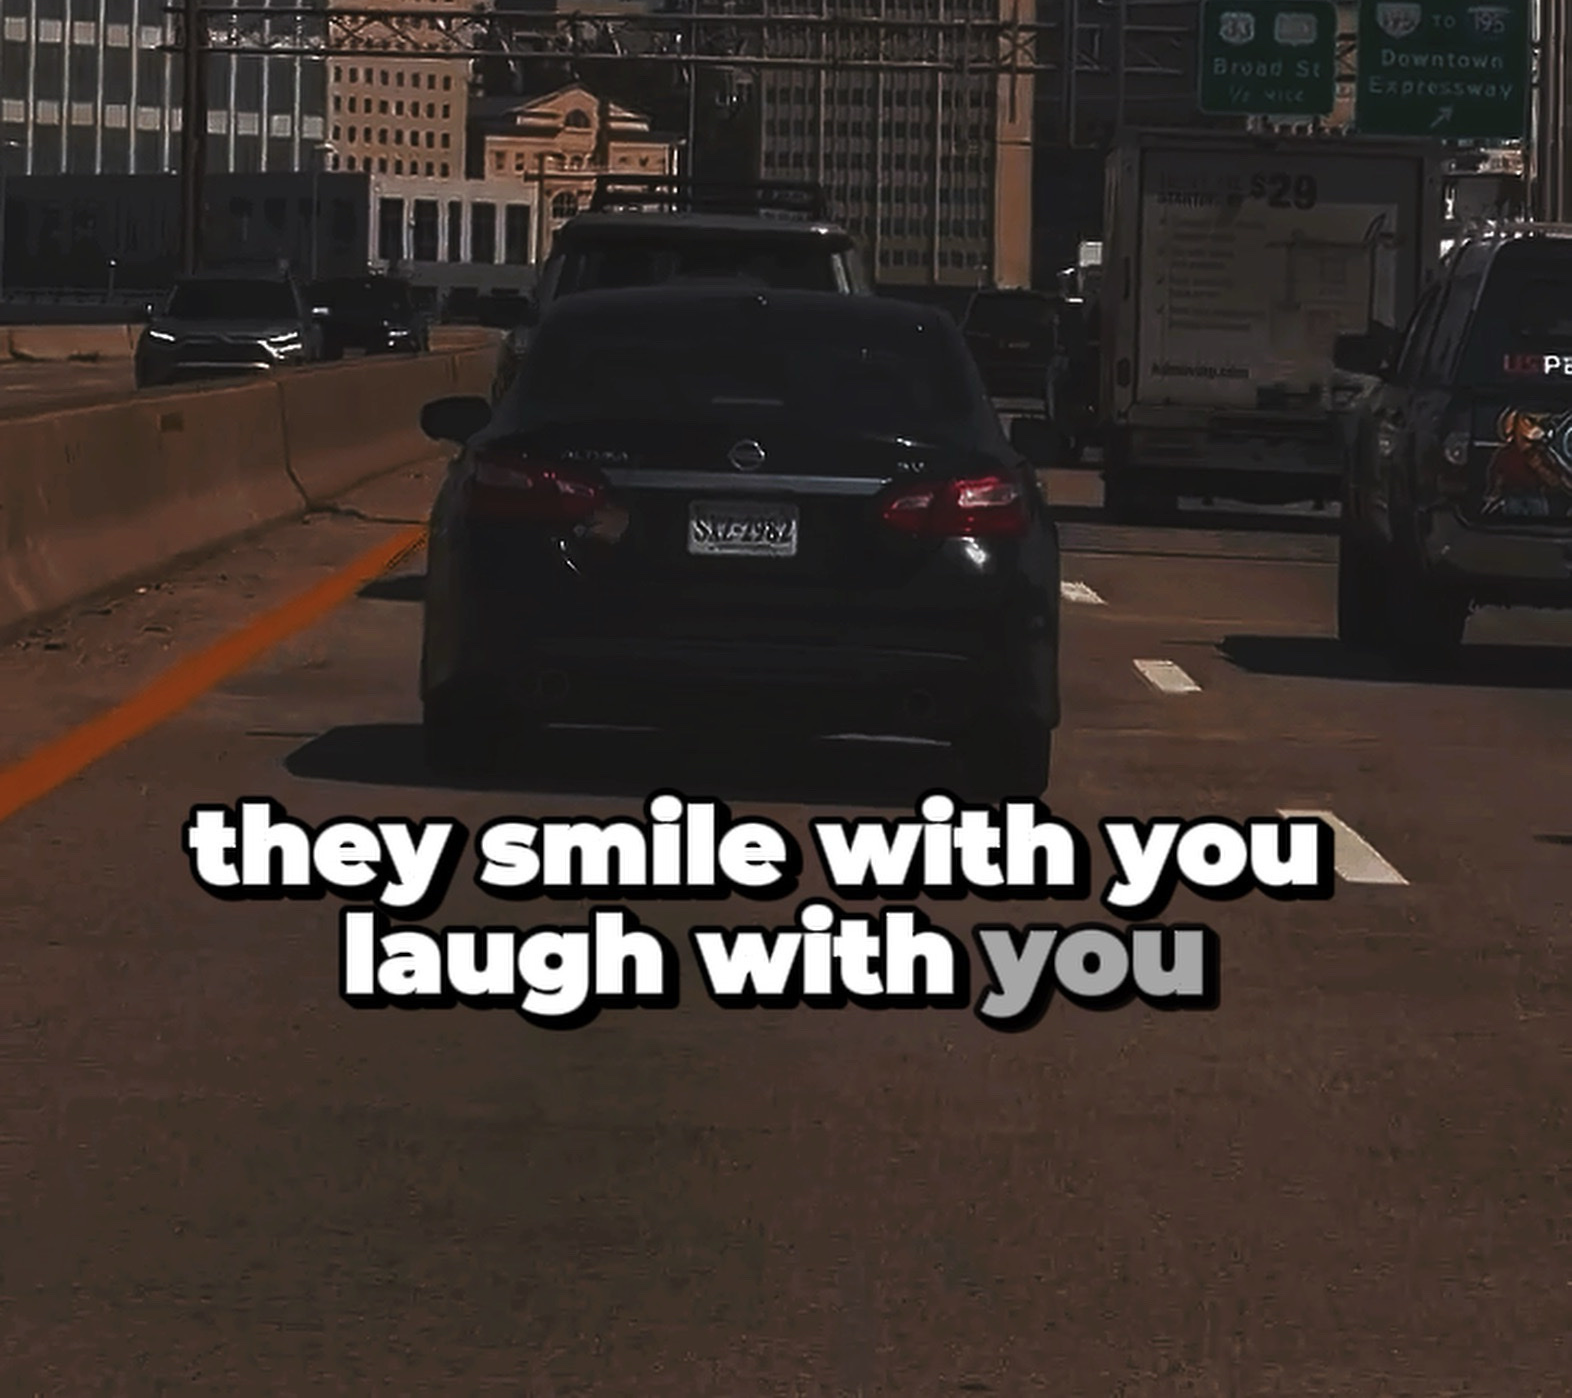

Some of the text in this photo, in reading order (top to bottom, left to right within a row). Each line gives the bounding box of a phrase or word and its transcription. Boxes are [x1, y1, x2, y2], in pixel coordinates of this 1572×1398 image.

[1432, 14, 1457, 29] TO
[1213, 57, 1321, 78] Broad St
[1381, 48, 1504, 70] Downtown
[1369, 75, 1514, 100] Expressway
[1249, 170, 1318, 210] $29
